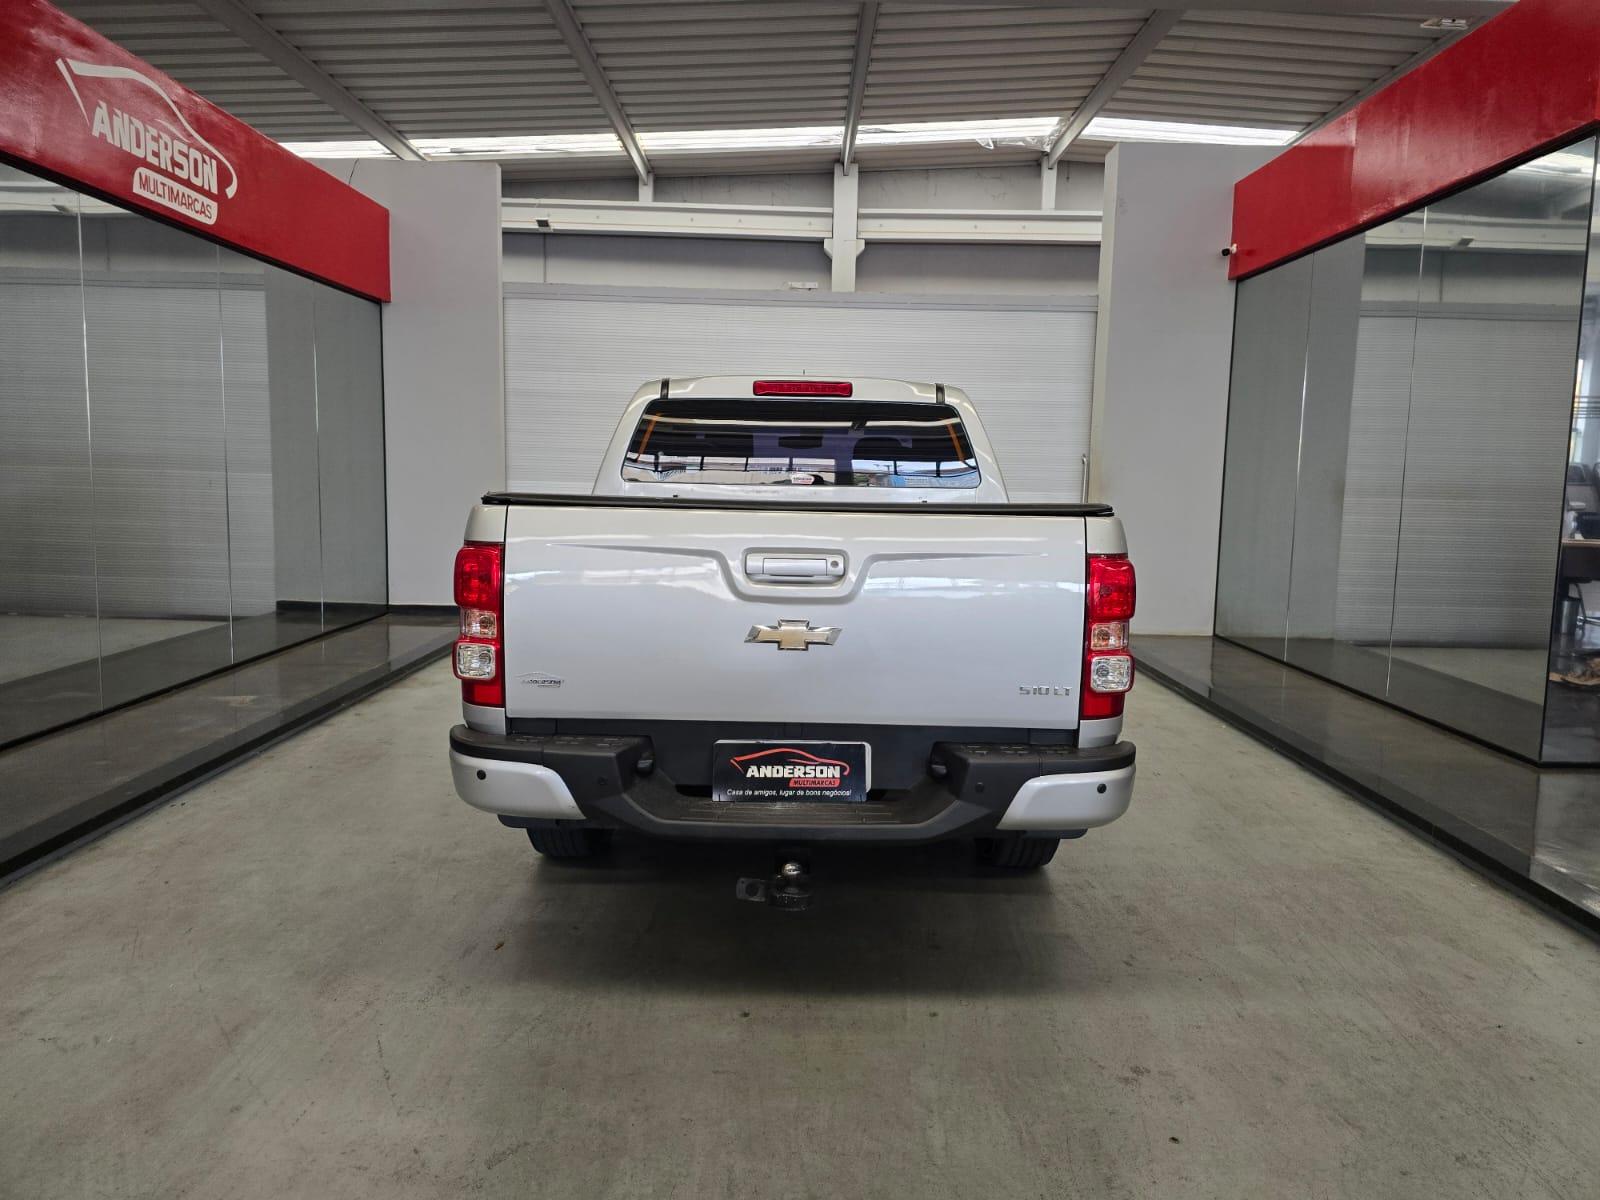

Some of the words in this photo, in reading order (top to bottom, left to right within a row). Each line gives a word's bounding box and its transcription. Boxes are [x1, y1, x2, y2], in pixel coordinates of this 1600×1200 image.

[92, 100, 218, 195] ANDERSON
[138, 171, 213, 220] MULTIMARCAS
[746, 765, 841, 778] ANDERSON
[727, 788, 743, 796] Casa
[744, 788, 753, 796] de
[753, 788, 778, 798] amigos,
[779, 789, 796, 798] lugar
[796, 789, 805, 797] de
[805, 789, 821, 797] bons
